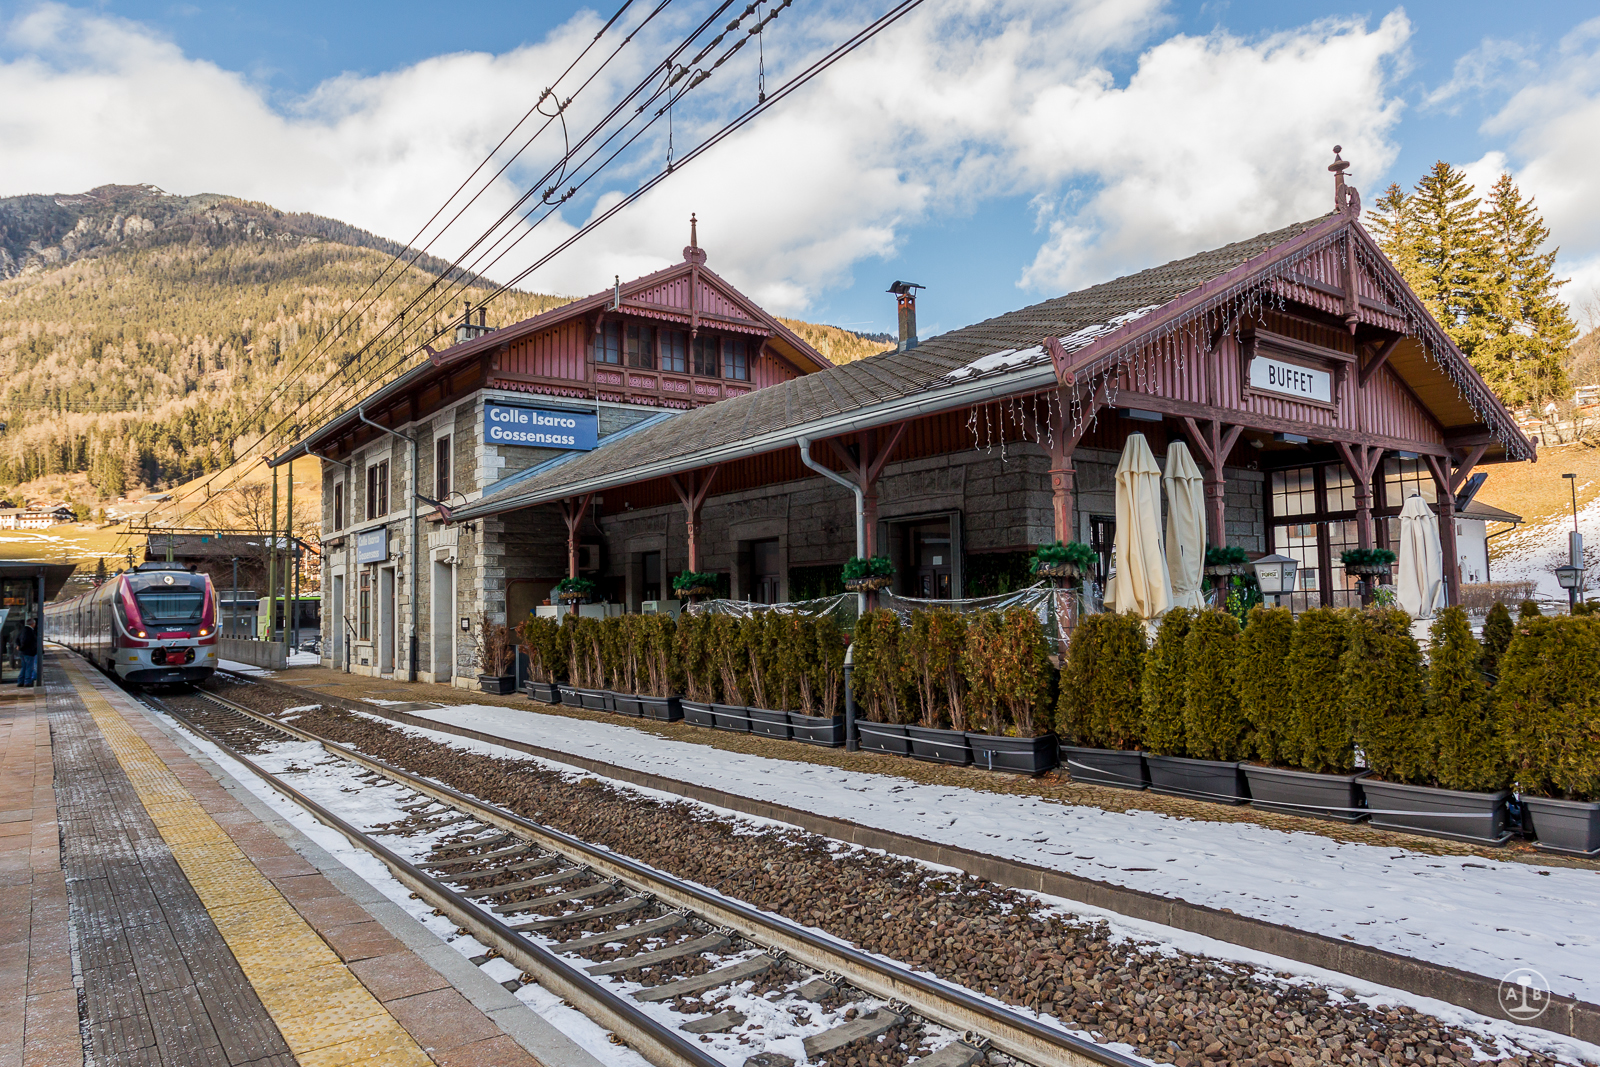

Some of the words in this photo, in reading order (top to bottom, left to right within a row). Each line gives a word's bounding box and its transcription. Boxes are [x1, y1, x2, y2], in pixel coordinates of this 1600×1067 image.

[1268, 364, 1313, 393] BUFFET
[490, 408, 528, 424] Colle
[532, 412, 576, 428] Isarco
[490, 426, 575, 445] Gossensass
